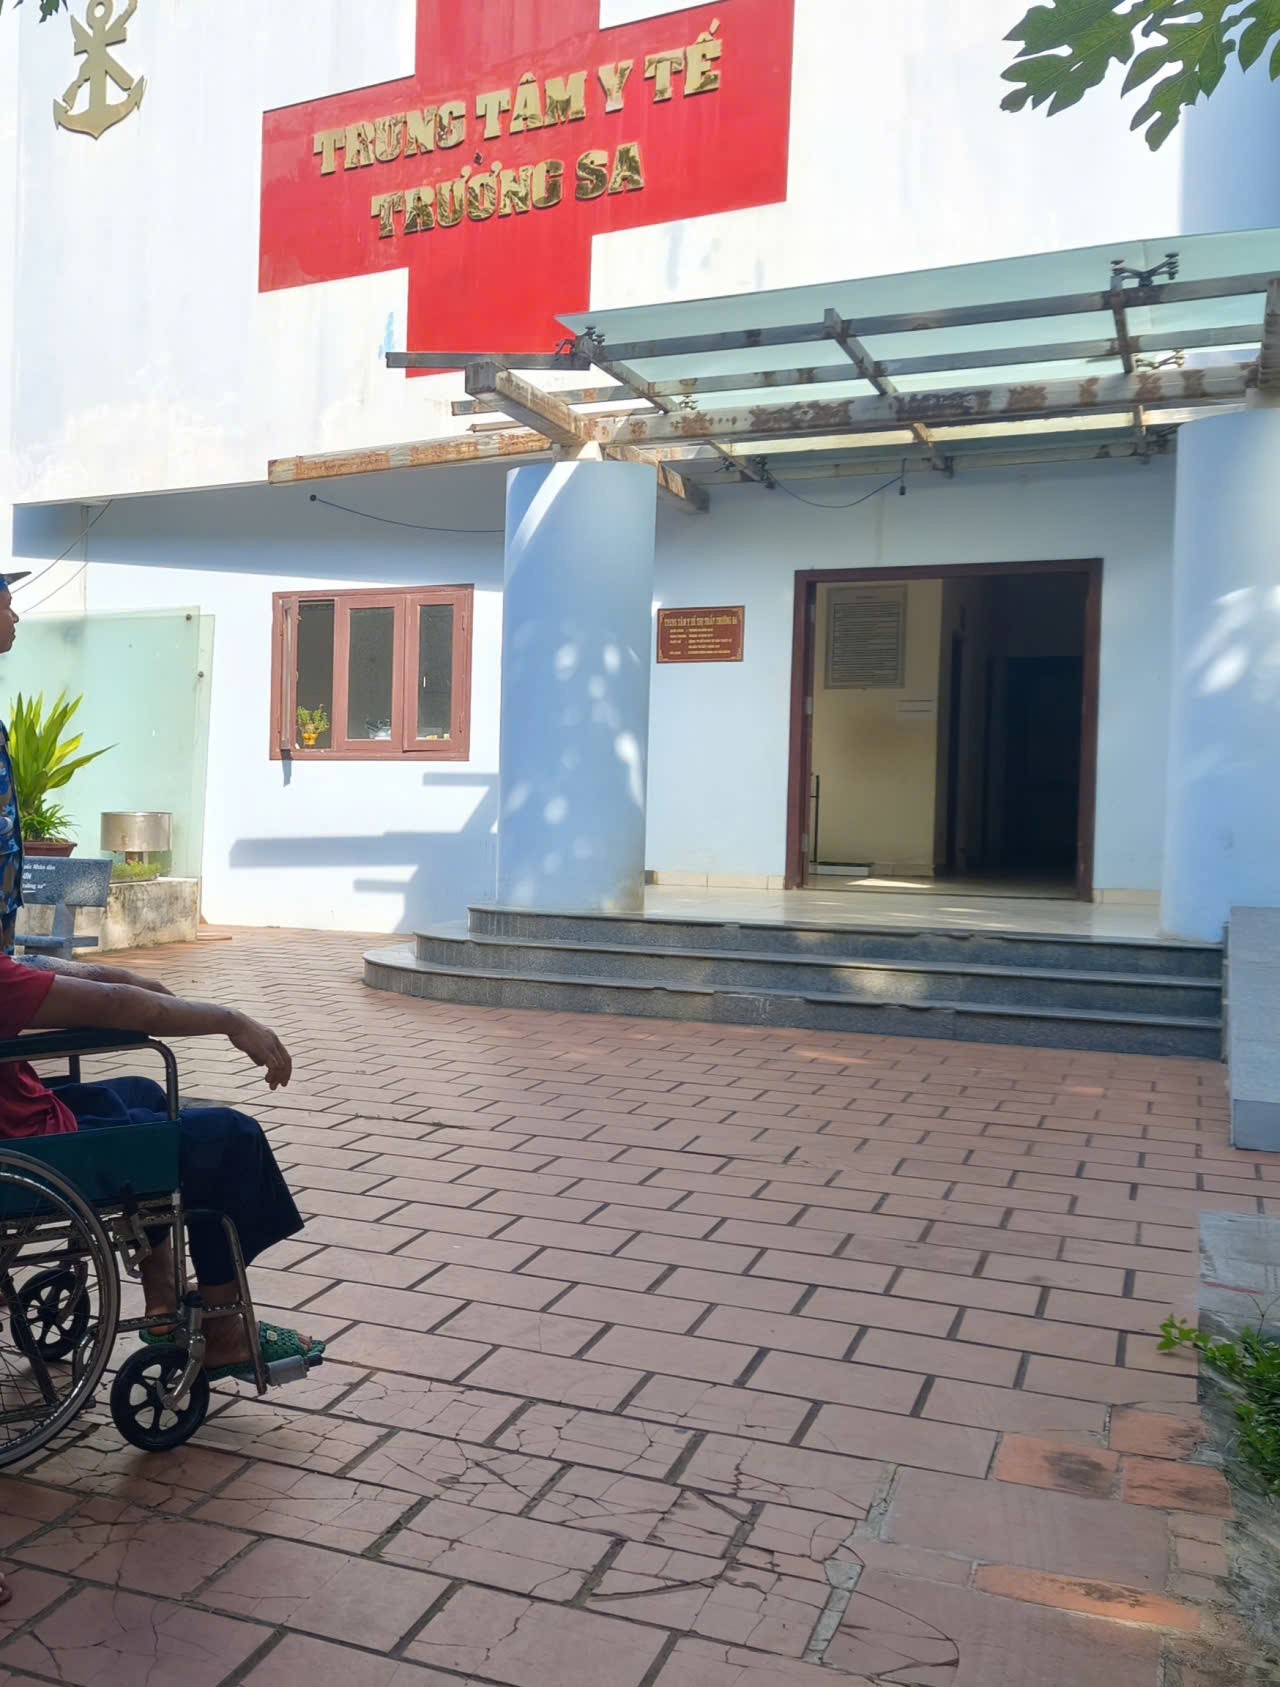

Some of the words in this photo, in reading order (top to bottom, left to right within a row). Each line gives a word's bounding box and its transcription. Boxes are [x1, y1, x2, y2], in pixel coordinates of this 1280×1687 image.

[314, 101, 466, 175] TRUNG
[476, 71, 588, 141] TÂM
[598, 59, 634, 115] Y
[644, 17, 723, 104] TẾ
[576, 142, 645, 201] SA
